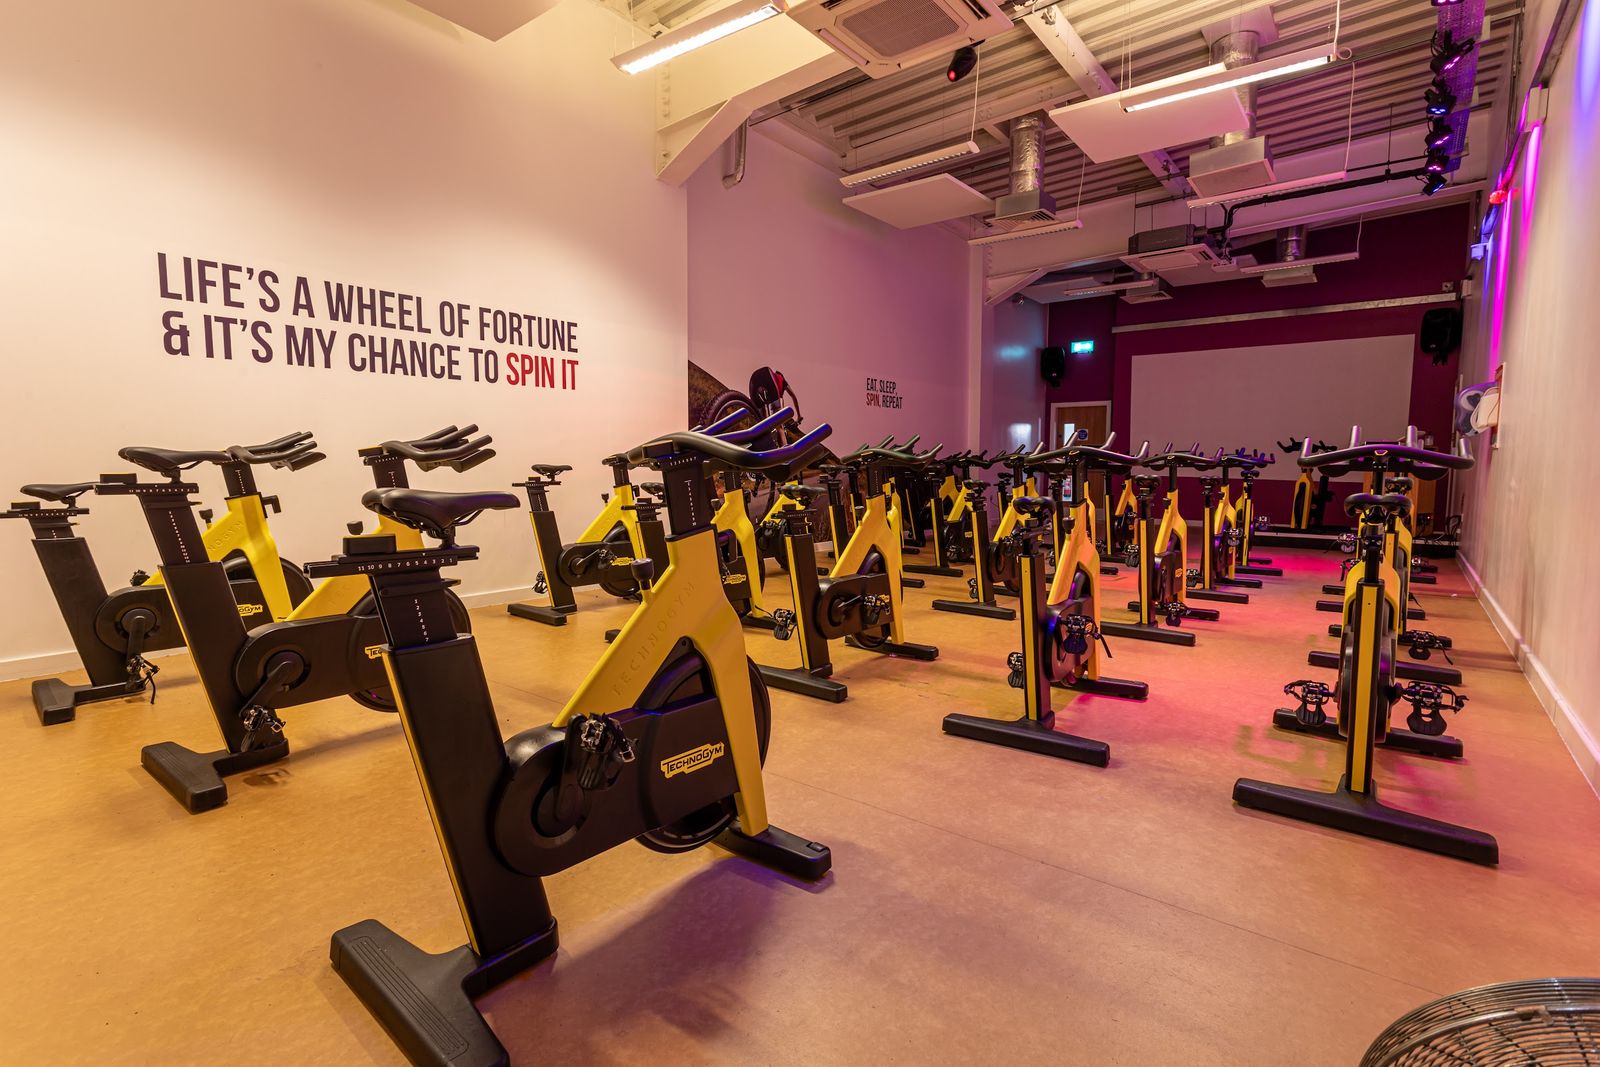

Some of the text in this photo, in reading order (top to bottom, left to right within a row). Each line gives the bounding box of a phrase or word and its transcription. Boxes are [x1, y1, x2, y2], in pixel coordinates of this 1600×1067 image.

[158, 252, 579, 353] LIFE'S A WHEEL OF FORTUNE
[162, 310, 579, 390] & IT'S MY CHANCE TO SPIN IT
[882, 395, 903, 409] REPEAT
